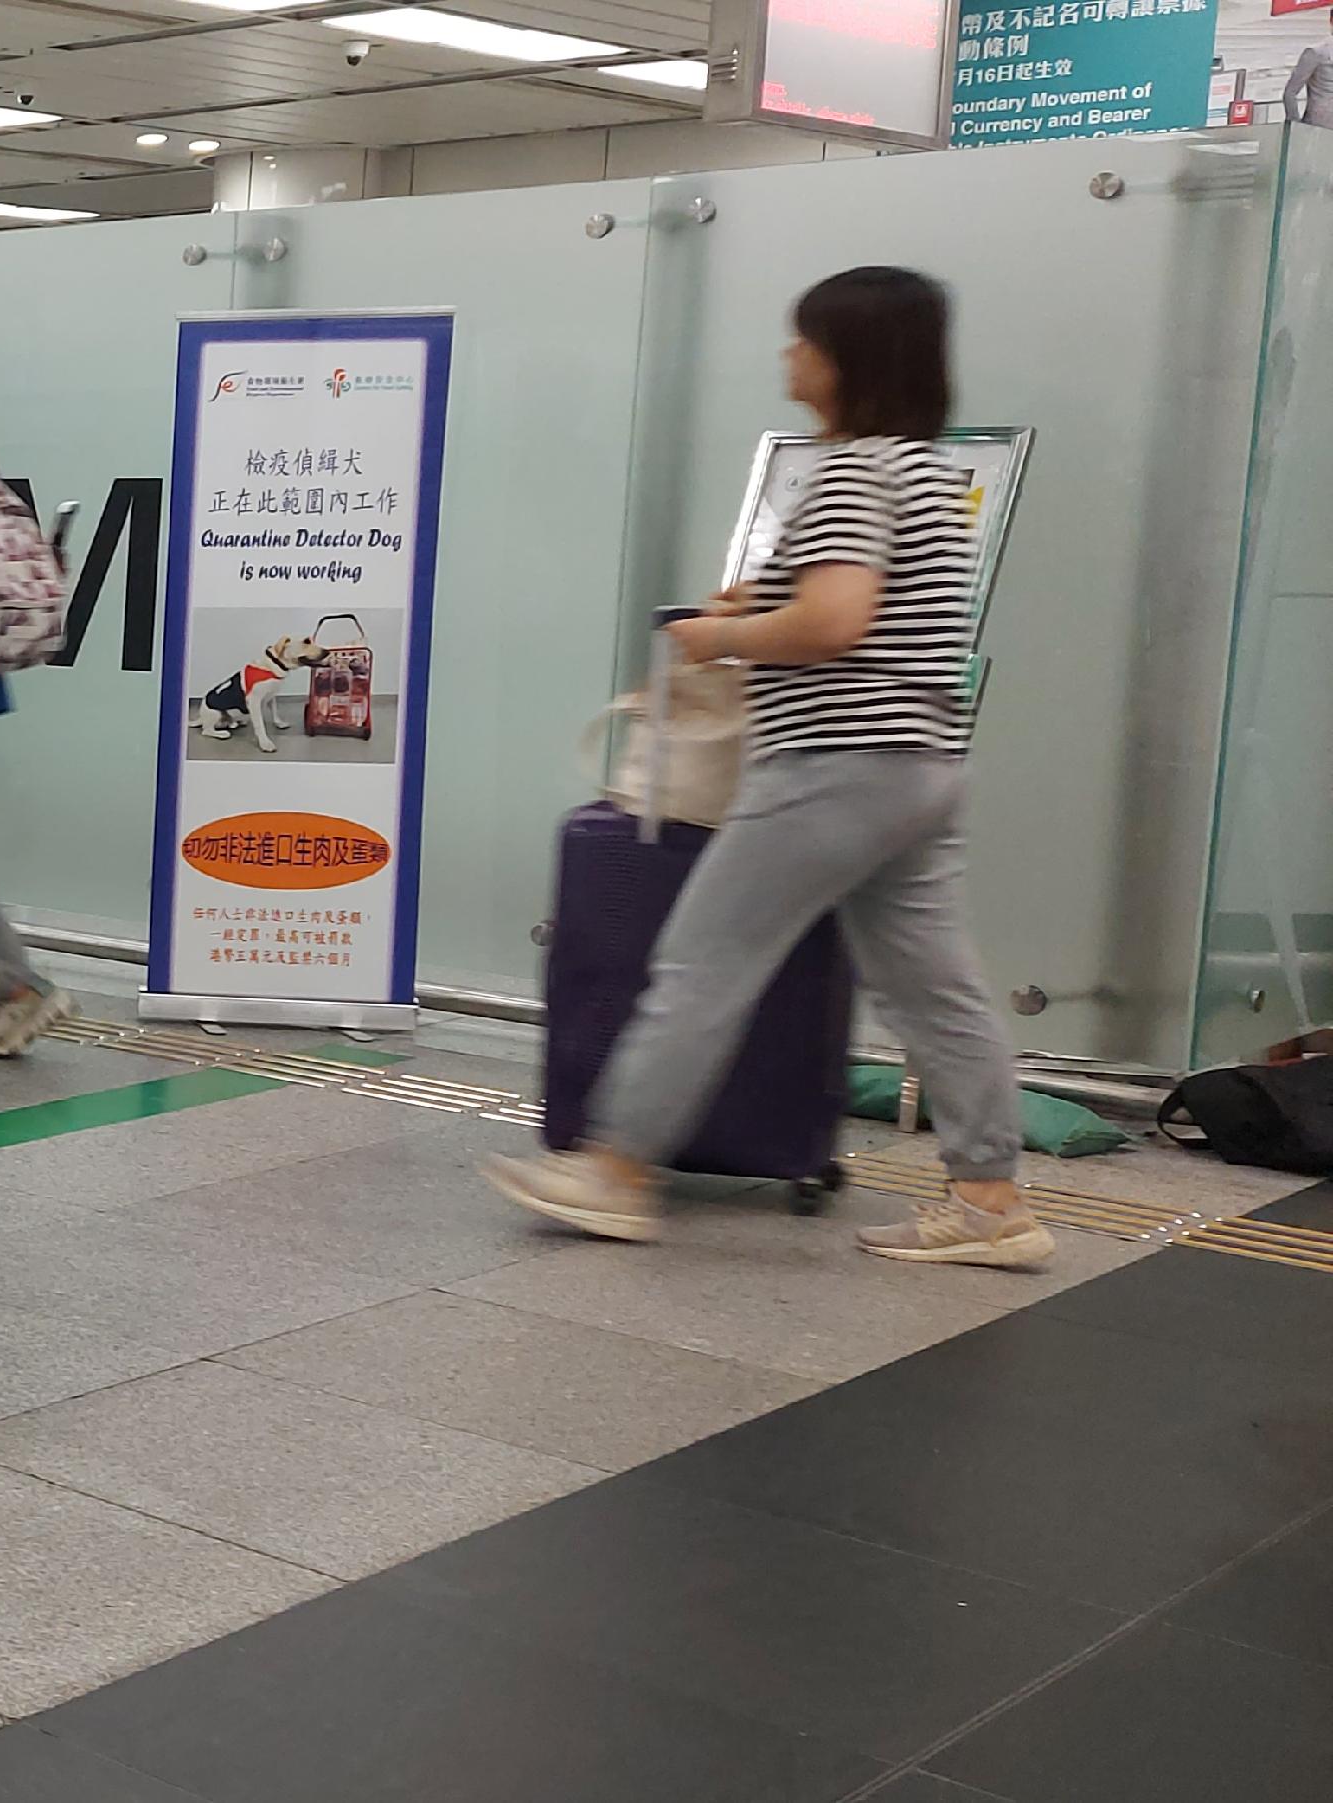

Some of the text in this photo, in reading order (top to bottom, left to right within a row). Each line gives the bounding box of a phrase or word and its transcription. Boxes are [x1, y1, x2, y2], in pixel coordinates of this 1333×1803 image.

[954, 58, 1073, 87] 月16日起生效
[952, 82, 1153, 118] oundary Movement of
[960, 116, 1043, 136] Currency
[1047, 111, 1084, 128] and
[1088, 107, 1152, 125] Bearer
[243, 447, 364, 477] 檢疫偵緝犬
[207, 486, 399, 516] 正在此範圍內工作
[200, 528, 402, 552] Quarantine Detector Dog
[239, 560, 363, 583] is now working
[182, 831, 389, 868] 切勿非法進口生肉及蛋類
